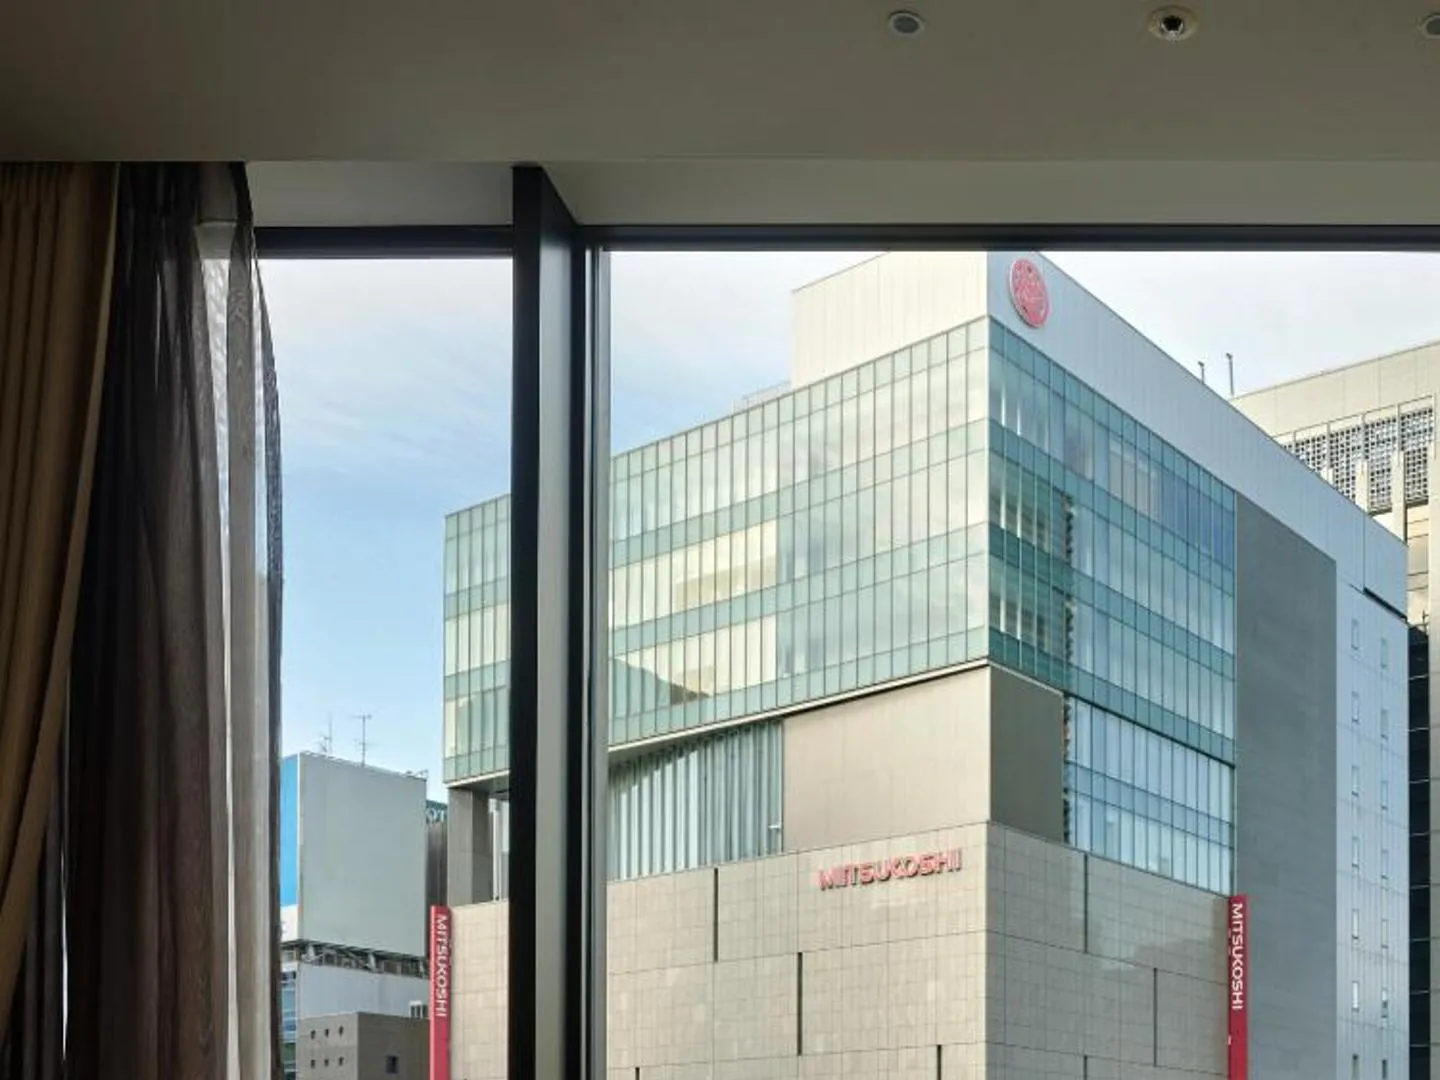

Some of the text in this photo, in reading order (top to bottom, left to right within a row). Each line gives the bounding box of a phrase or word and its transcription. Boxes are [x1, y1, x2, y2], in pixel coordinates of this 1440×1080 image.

[819, 848, 962, 891] MITSUKOSHI
[436, 914, 448, 1017] MITSUKOSHI
[1231, 903, 1244, 1010] MITSUKOSHI
